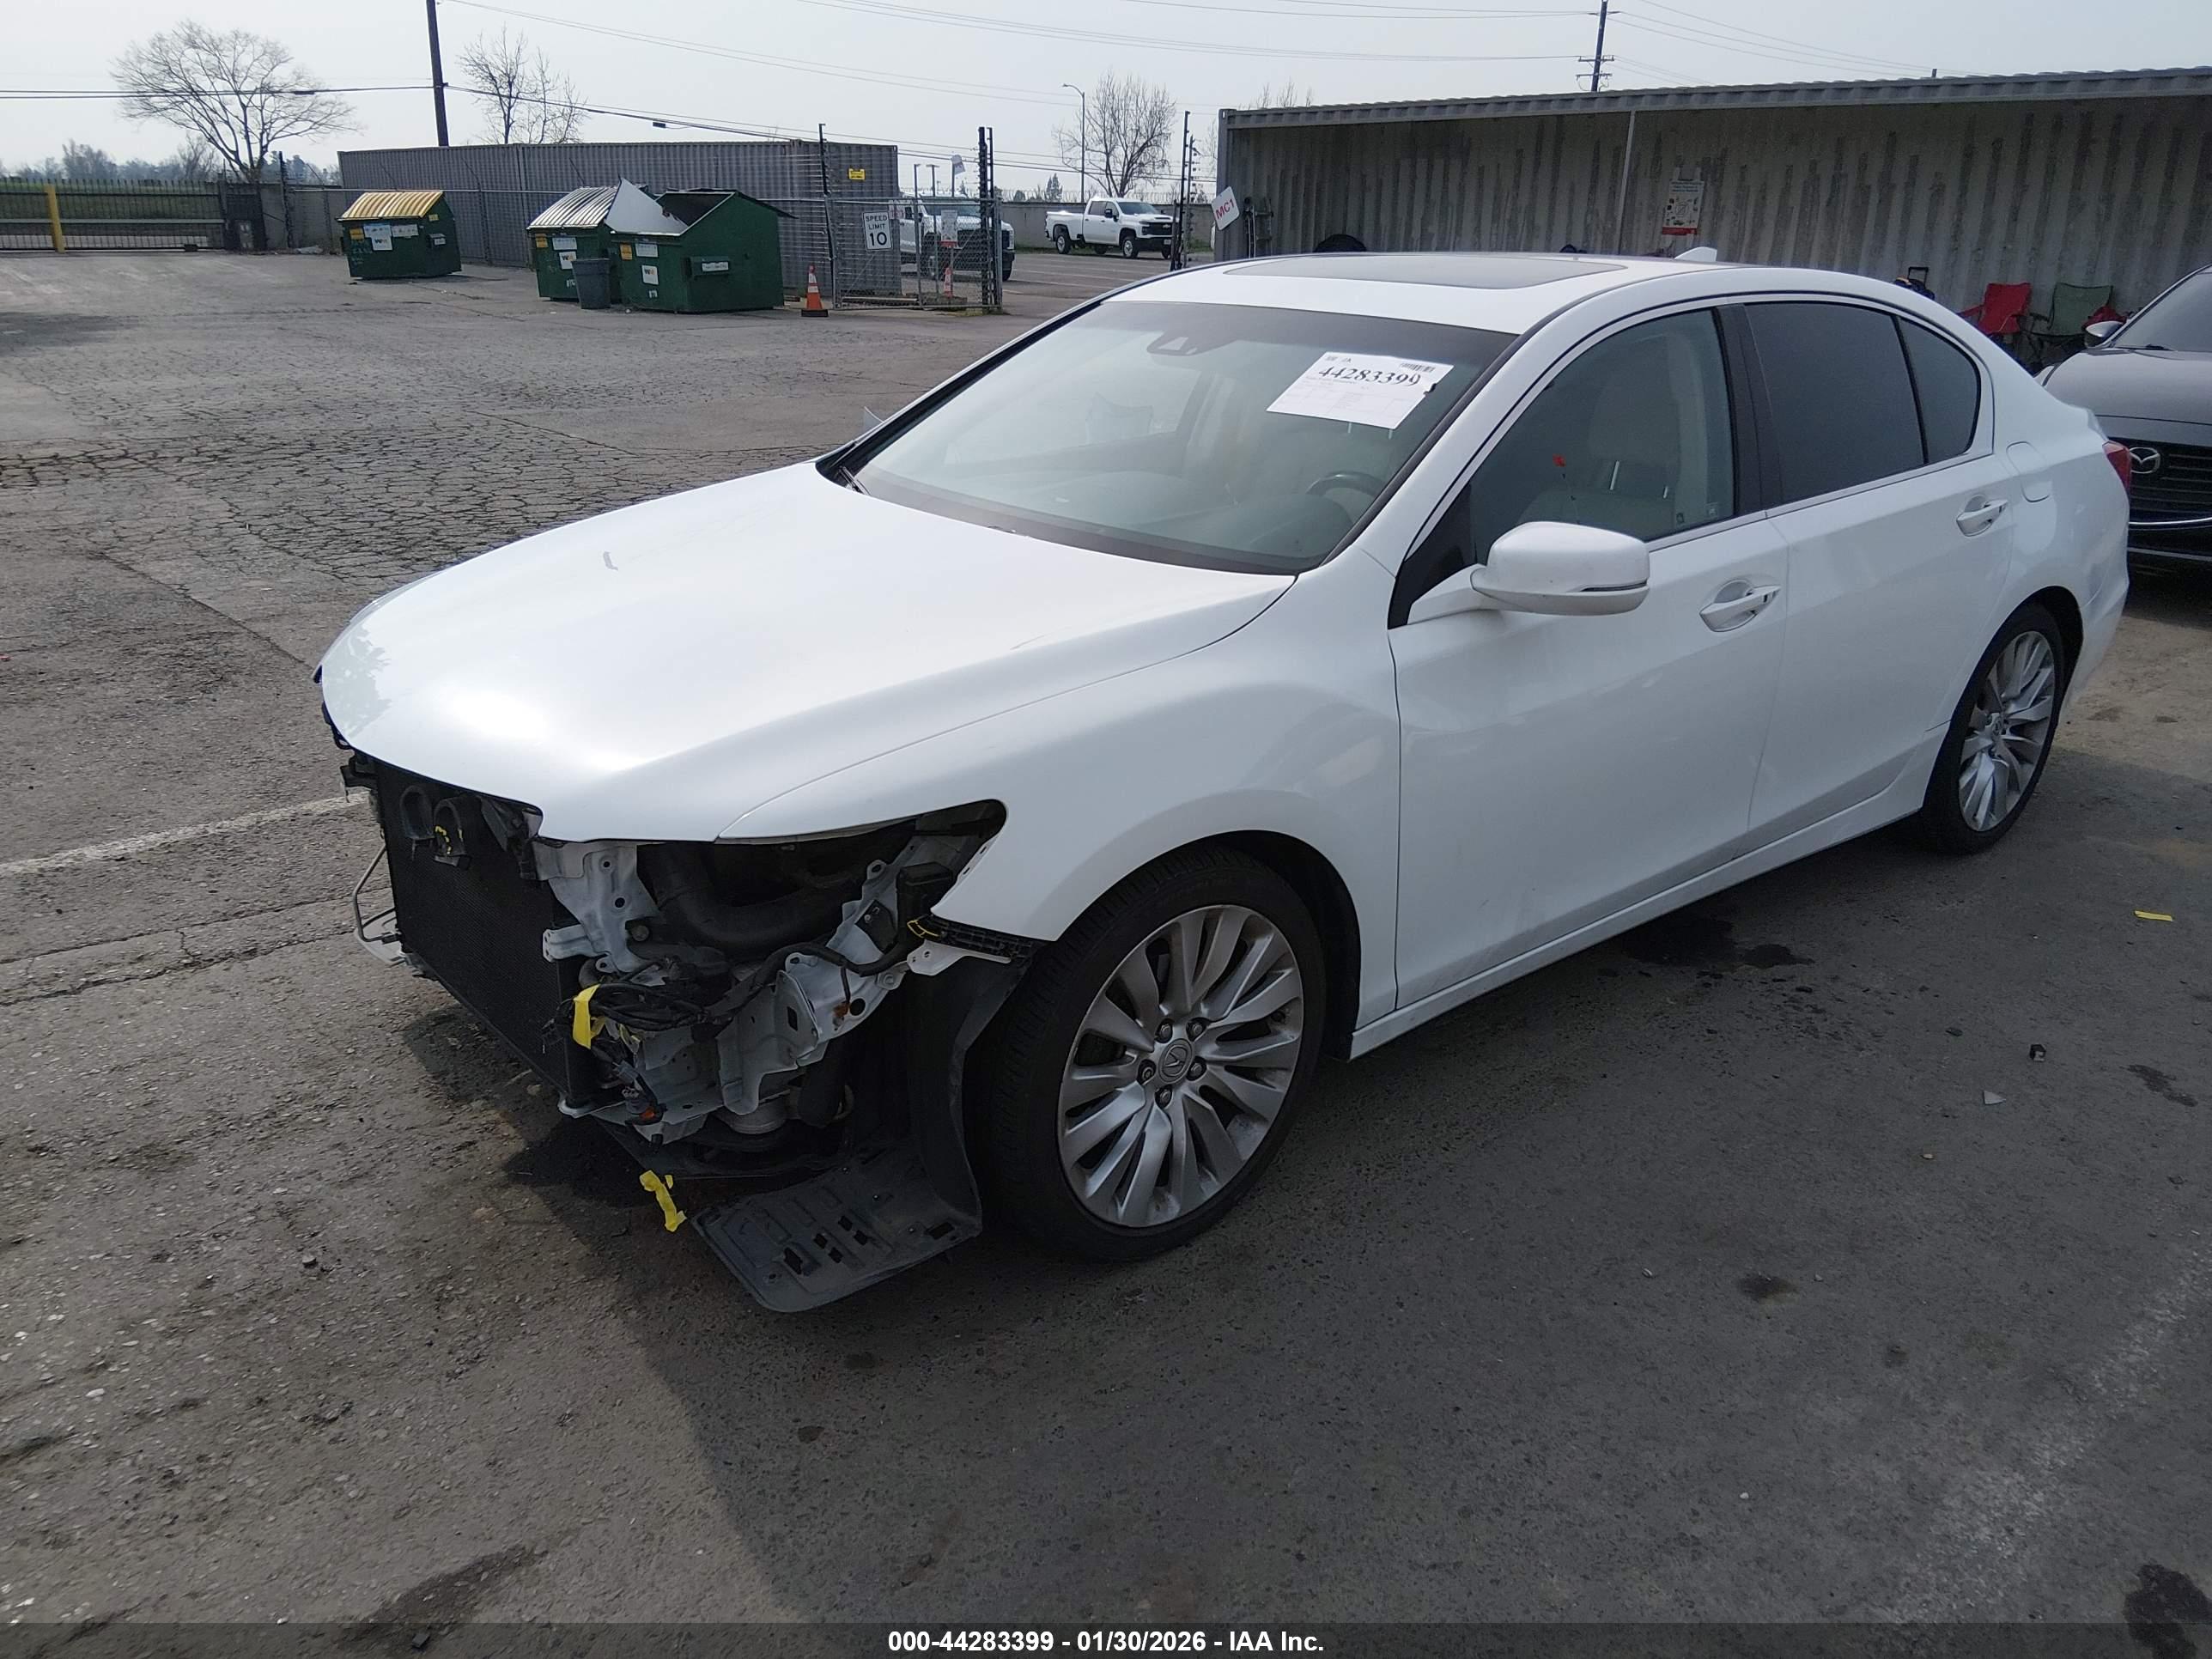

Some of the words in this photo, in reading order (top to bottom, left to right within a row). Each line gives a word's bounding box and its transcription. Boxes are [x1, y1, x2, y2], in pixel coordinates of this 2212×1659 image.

[1216, 199, 1235, 219] MC1
[870, 232, 887, 246] 10
[1318, 366, 1421, 386] 44283399
